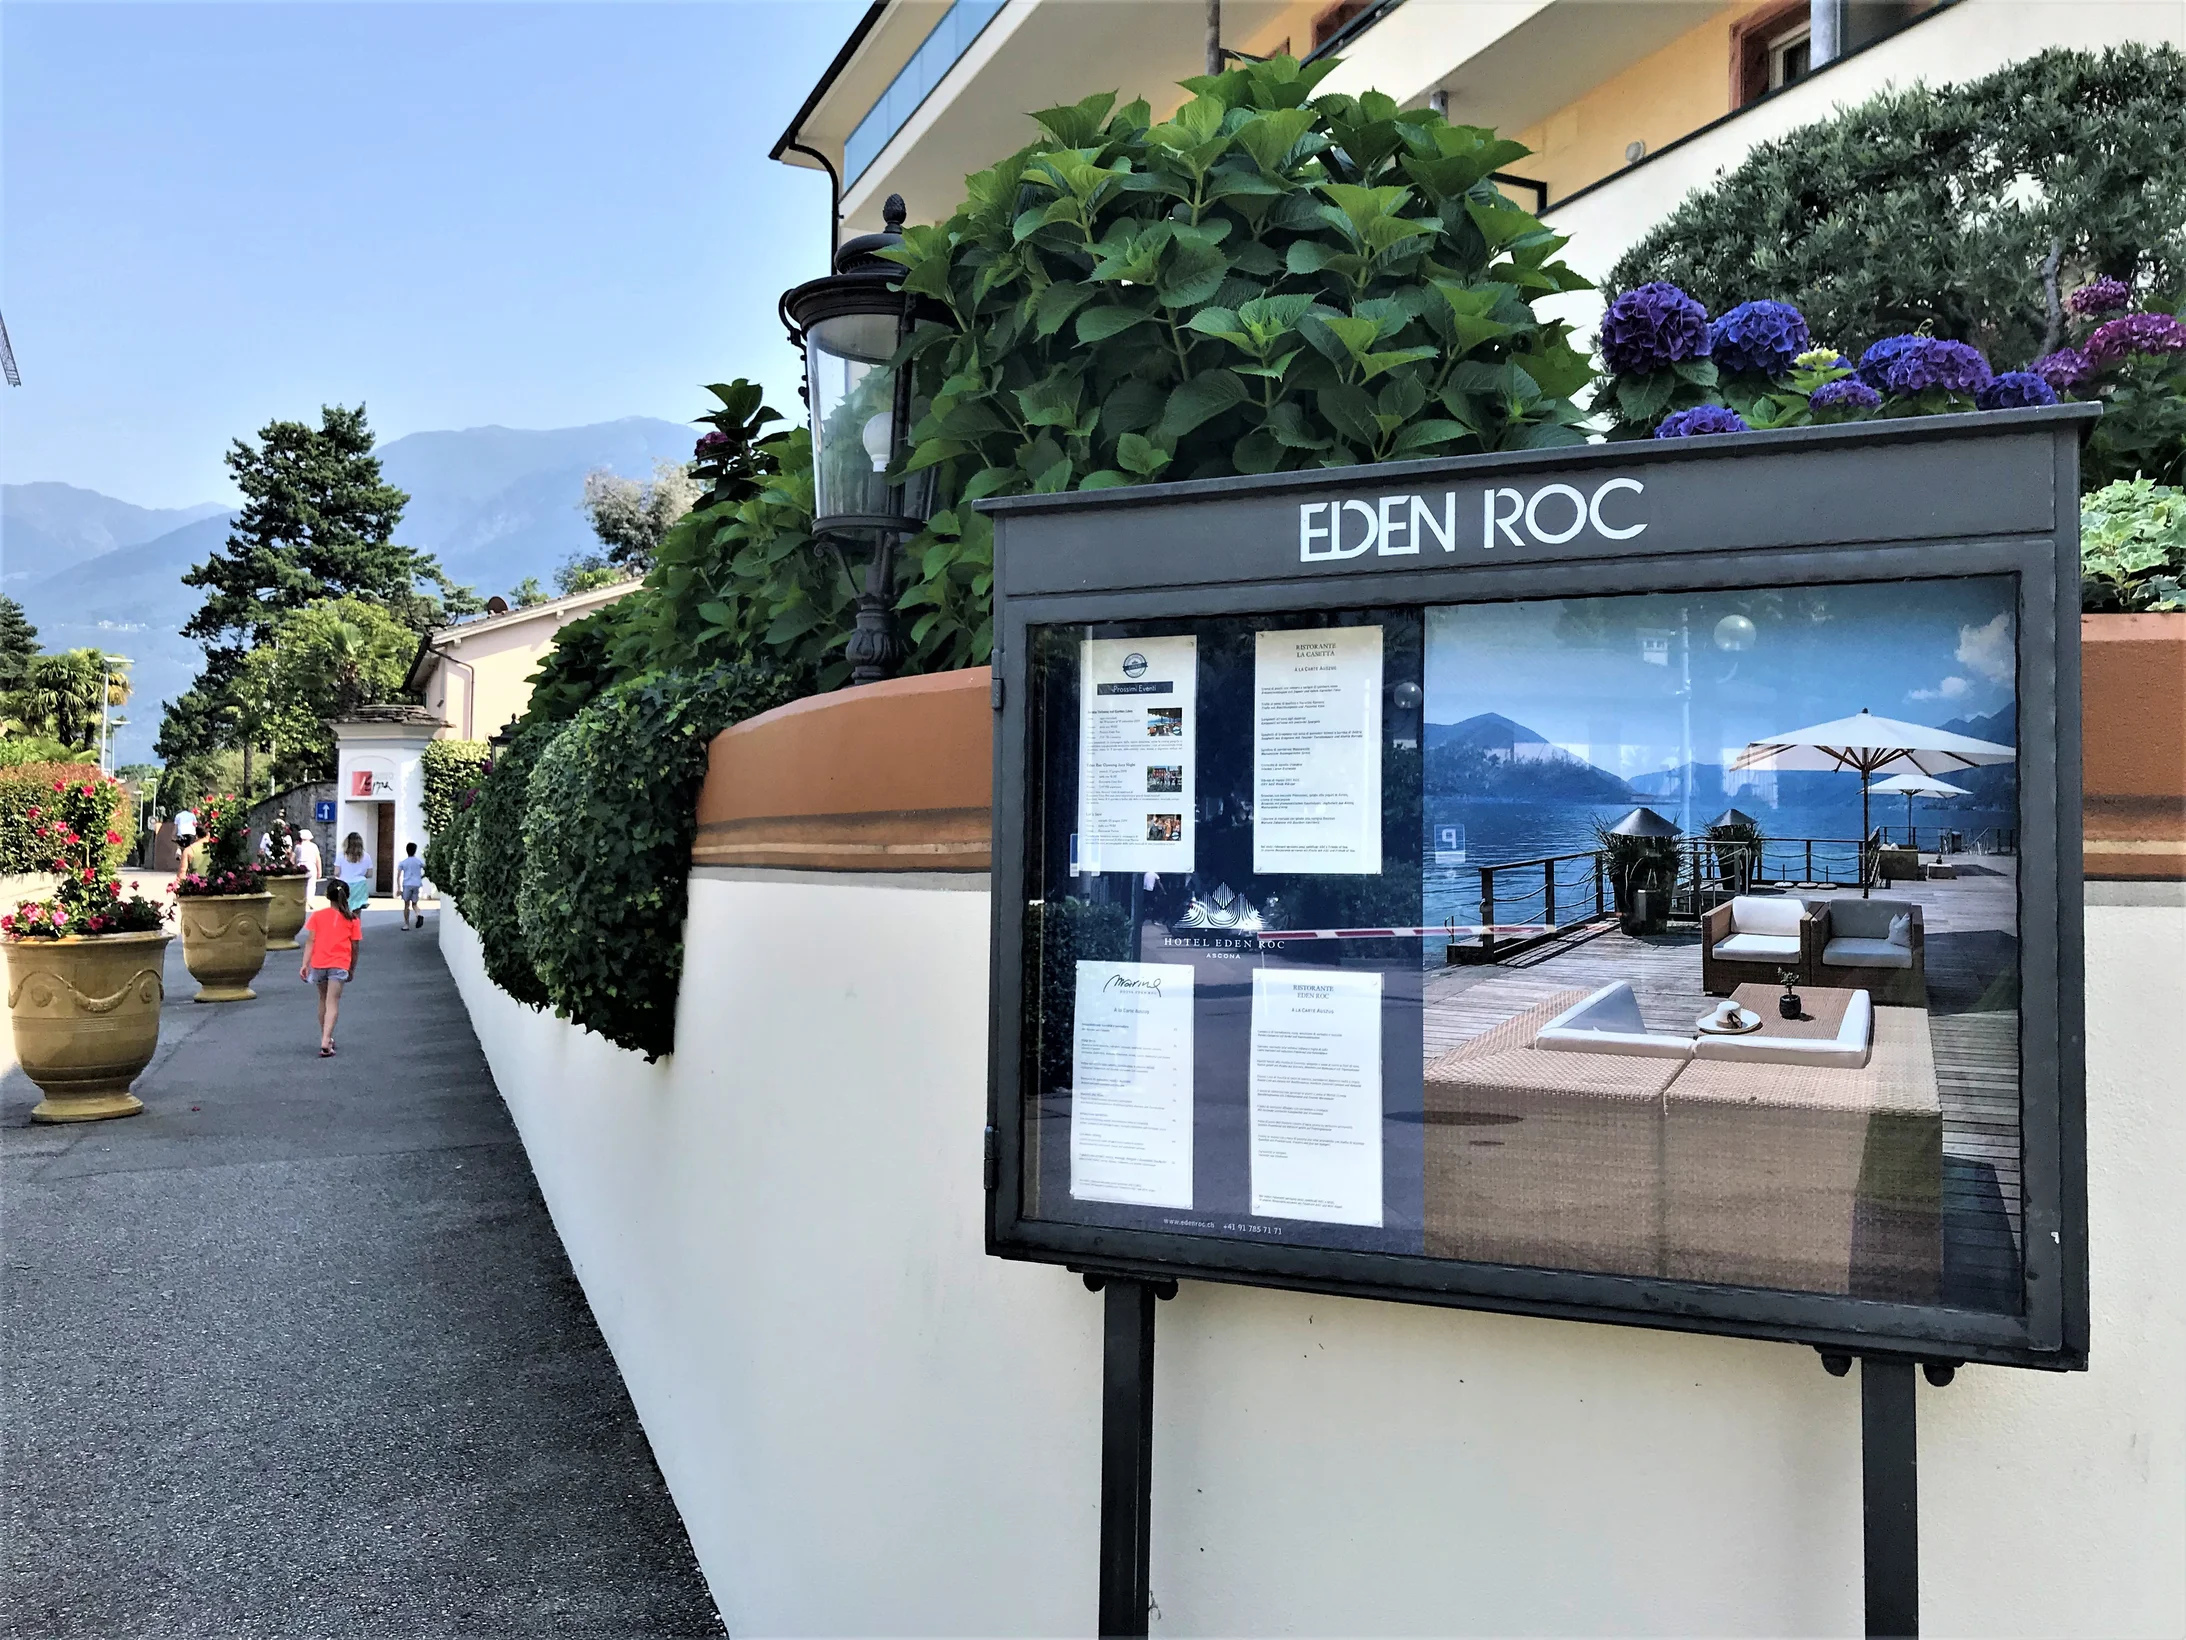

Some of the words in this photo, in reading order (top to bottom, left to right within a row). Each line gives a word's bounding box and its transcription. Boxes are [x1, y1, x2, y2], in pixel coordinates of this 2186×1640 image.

[1300, 491, 1456, 562] EDEN
[1483, 477, 1648, 549] ROC
[1112, 684, 1138, 693] Prossimi
[1138, 684, 1156, 692] Eventi
[1164, 937, 1210, 947] HOTEL
[1215, 939, 1252, 948] EDEN
[1258, 940, 1285, 949] ROC
[1164, 1218, 1214, 1228] www.edenroc.ch
[1223, 1223, 1235, 1231] +41
[1238, 1224, 1246, 1232] 91
[1248, 1224, 1261, 1233] 785
[1263, 1226, 1271, 1234] 71
[1274, 1226, 1282, 1235] 71
